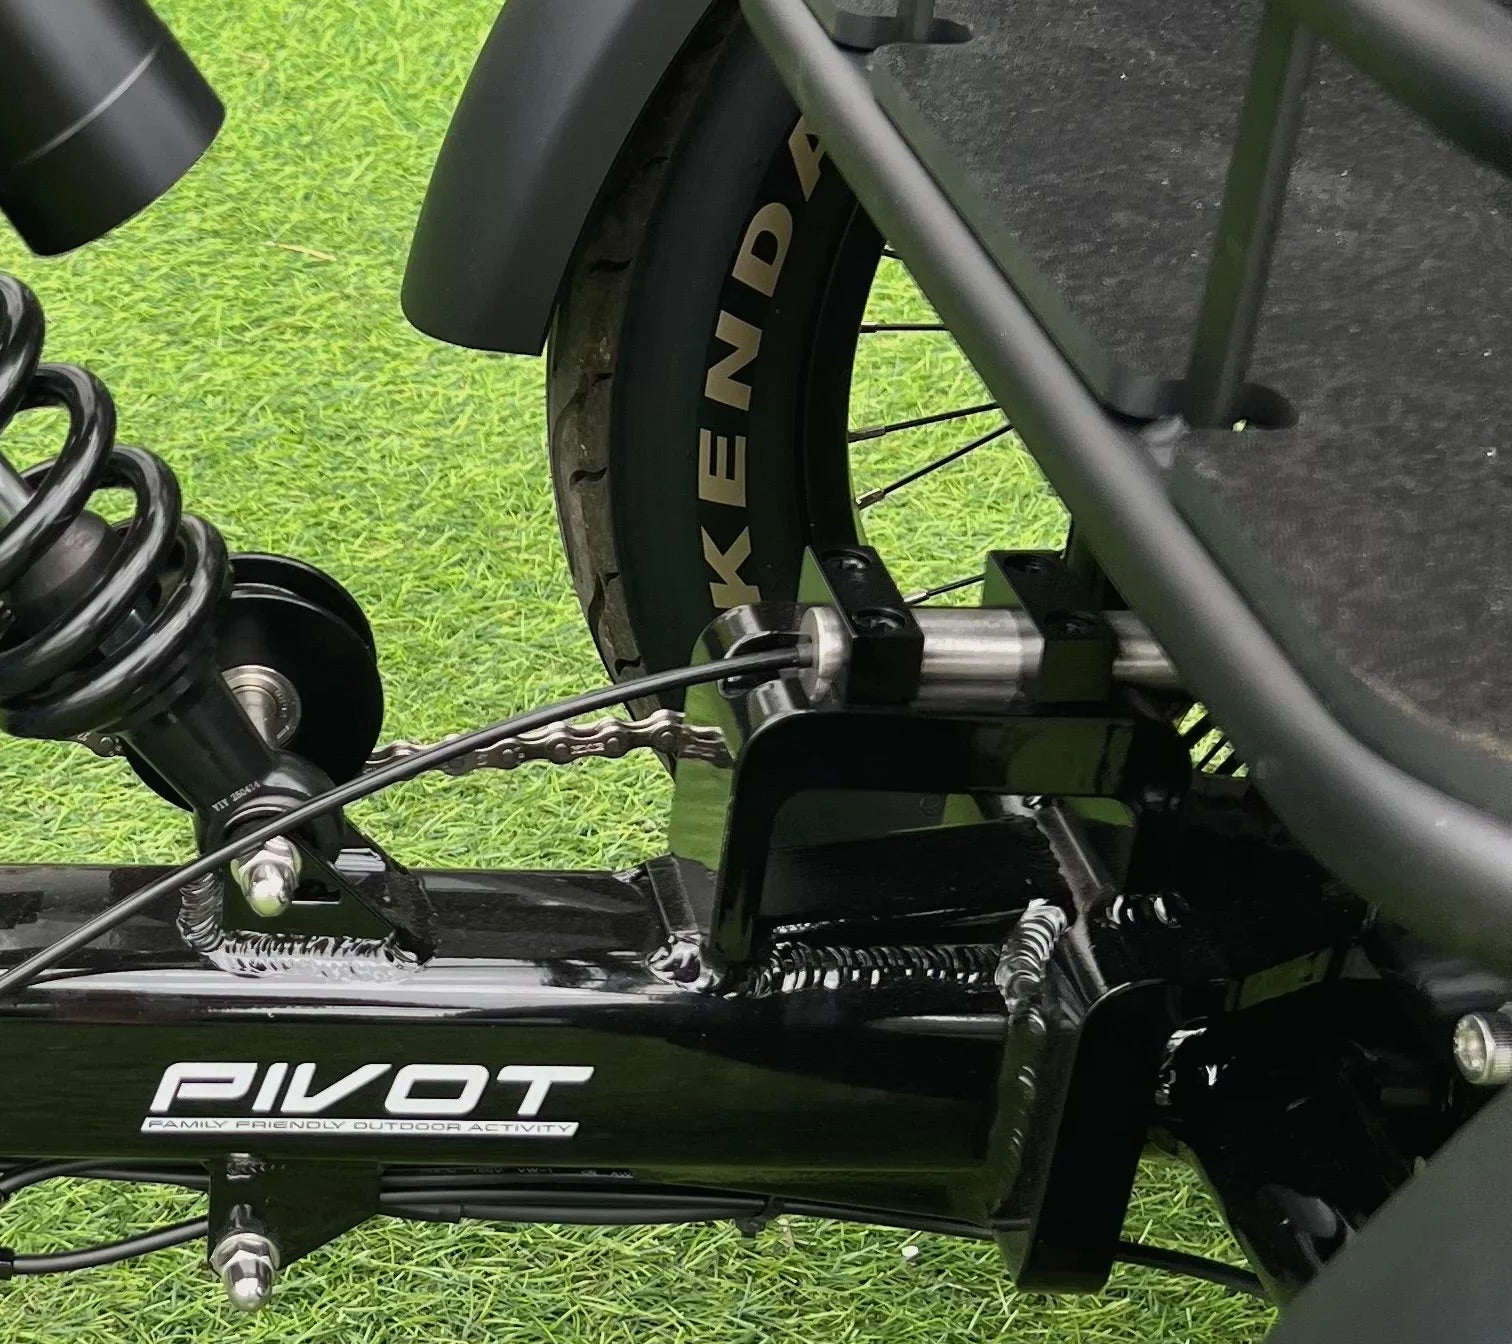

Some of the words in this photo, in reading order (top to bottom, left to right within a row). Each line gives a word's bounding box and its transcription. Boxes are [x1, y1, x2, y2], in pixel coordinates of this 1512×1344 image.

[150, 1062, 595, 1116] PIVOT
[148, 1119, 228, 1129] FAMILY
[235, 1120, 347, 1130] FRIENDLY
[353, 1121, 461, 1131] OUTDOOR
[469, 1123, 572, 1133] ACTIVITY
